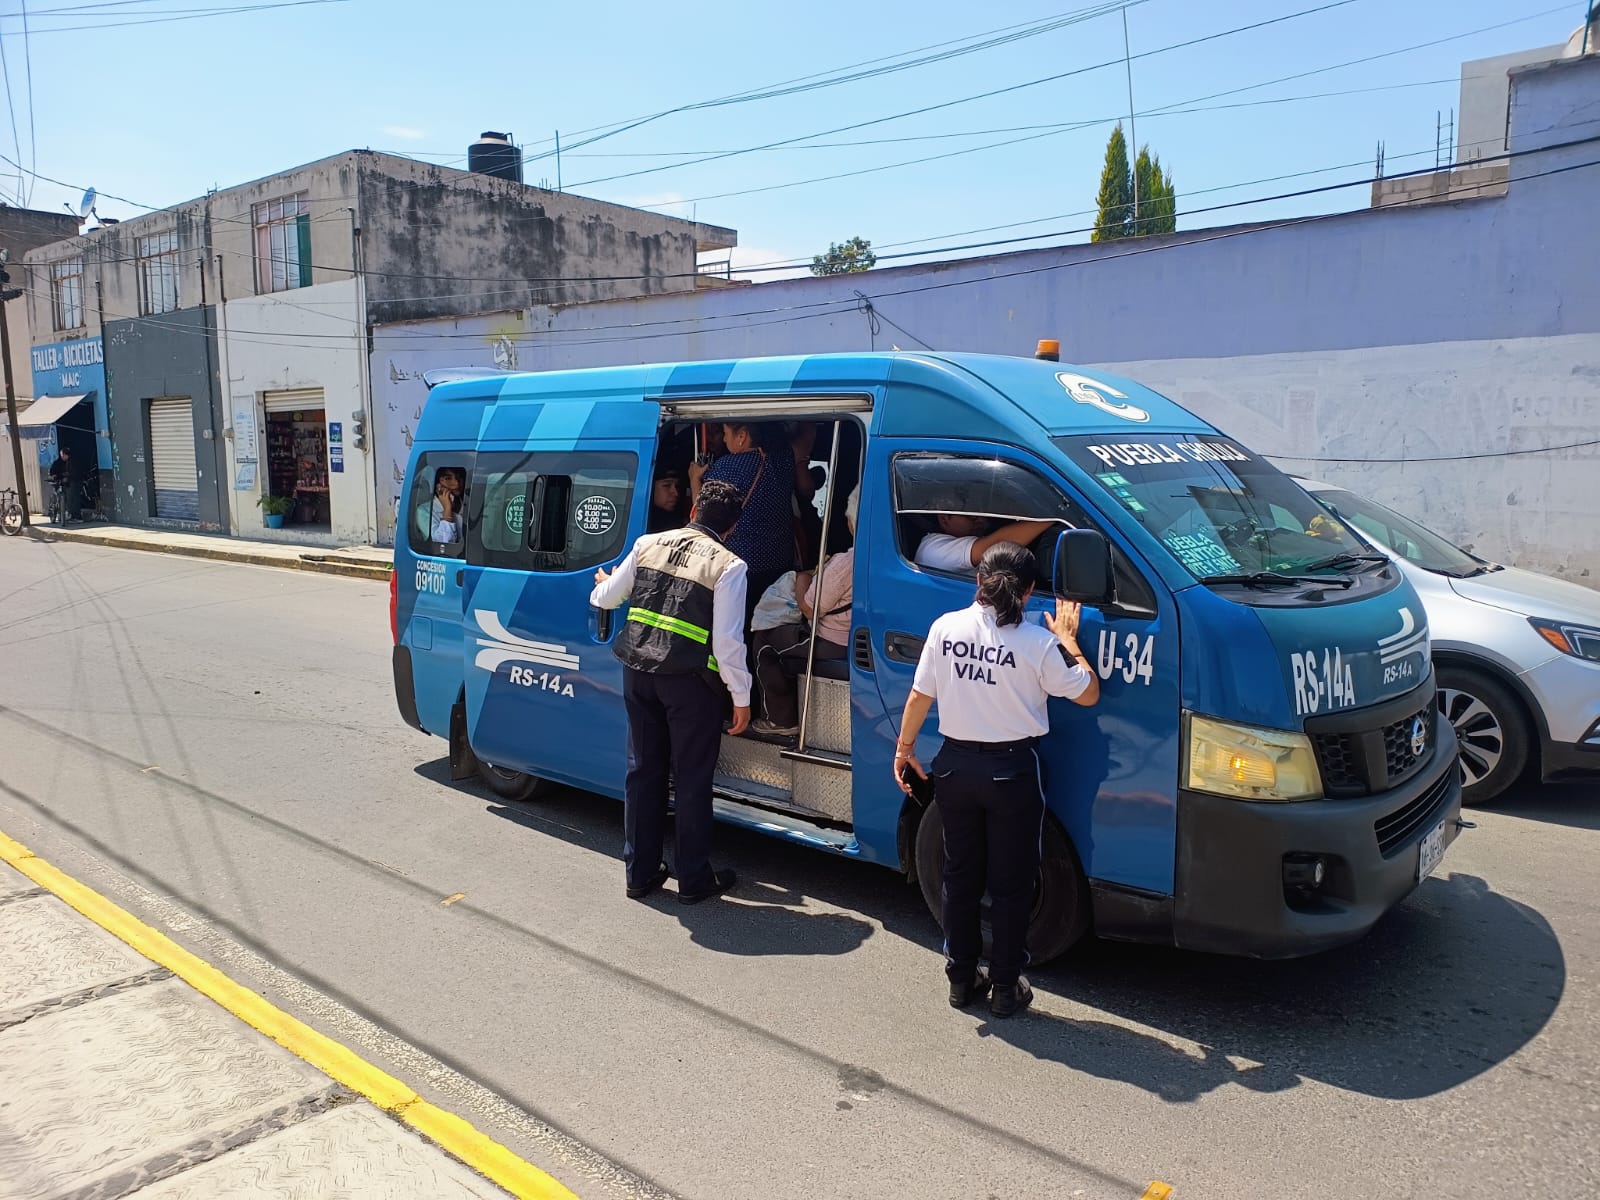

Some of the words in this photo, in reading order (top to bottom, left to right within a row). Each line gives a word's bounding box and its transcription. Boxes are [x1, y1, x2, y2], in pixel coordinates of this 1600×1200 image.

[33, 348, 58, 371] TALLER
[64, 341, 103, 367] BICICLETAS
[1086, 443, 1189, 467] PUEBLA
[1176, 442, 1251, 461] CHOLULA
[1163, 532, 1214, 551] UEBLA
[668, 549, 691, 568] VIAL
[415, 570, 446, 595] 09100
[942, 640, 1016, 669] POLICÍA
[1098, 630, 1155, 686] U-34
[509, 665, 575, 698] RS-14A
[954, 662, 997, 686] VIAL
[1291, 646, 1356, 716] RS-14A
[1383, 660, 1412, 685] RS-14A
